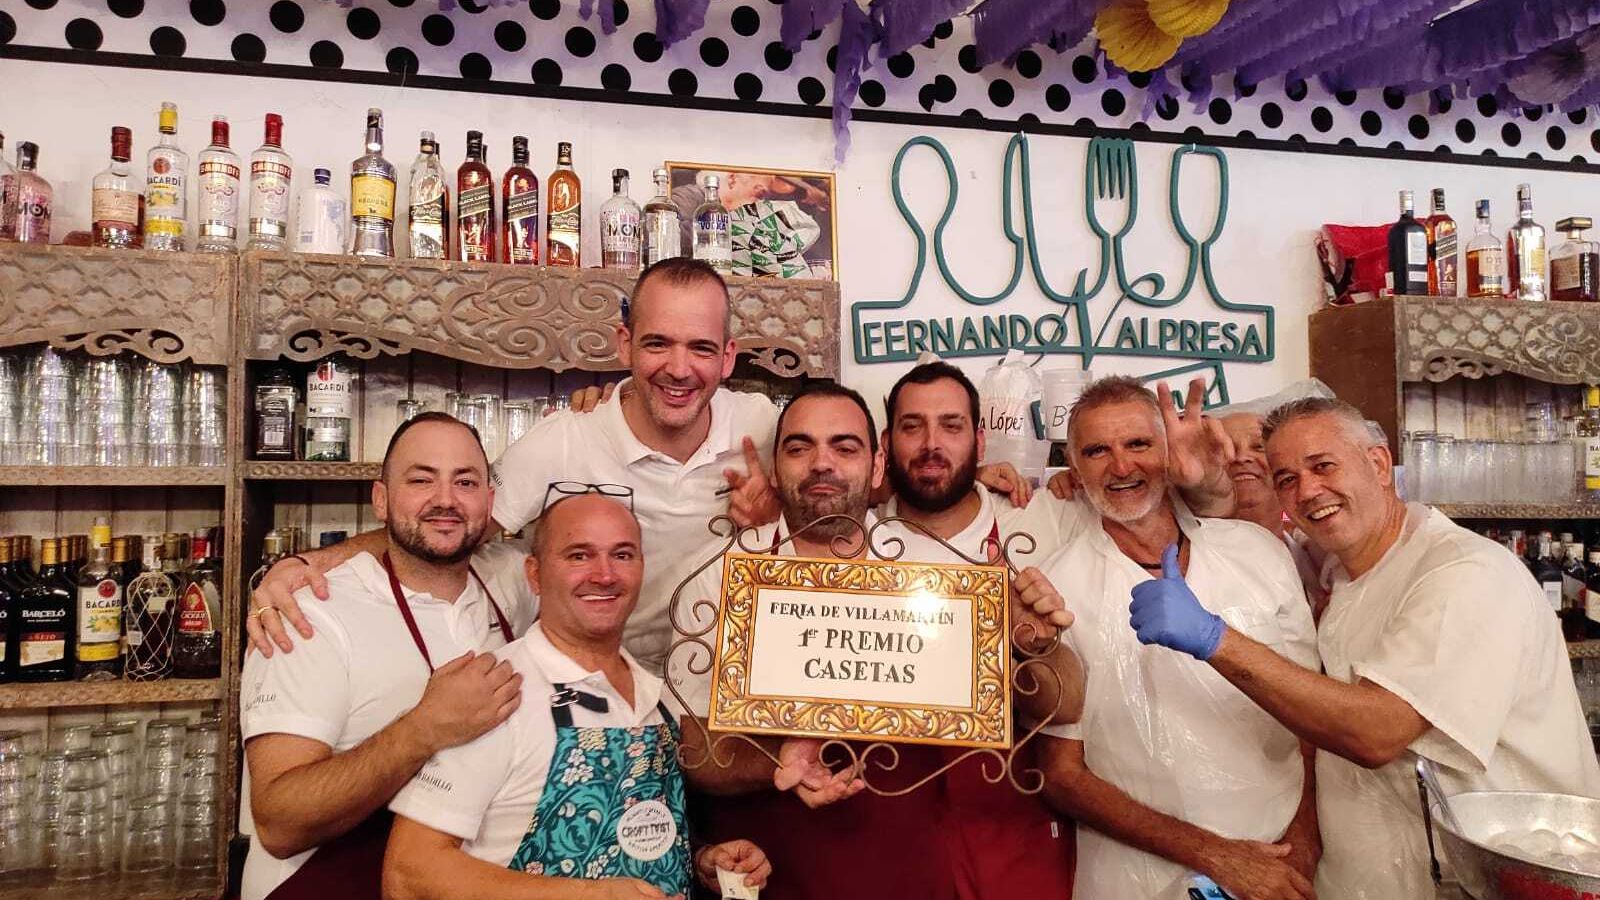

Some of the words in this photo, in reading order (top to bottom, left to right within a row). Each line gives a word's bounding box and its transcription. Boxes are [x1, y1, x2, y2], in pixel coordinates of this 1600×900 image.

[863, 313, 1069, 358] FERNANDO
[22, 608, 66, 618] BARCELÓ
[769, 602, 816, 619] FERIA
[821, 604, 840, 618] DE
[824, 628, 924, 655] PREMIO
[804, 656, 916, 684] CASETAS
